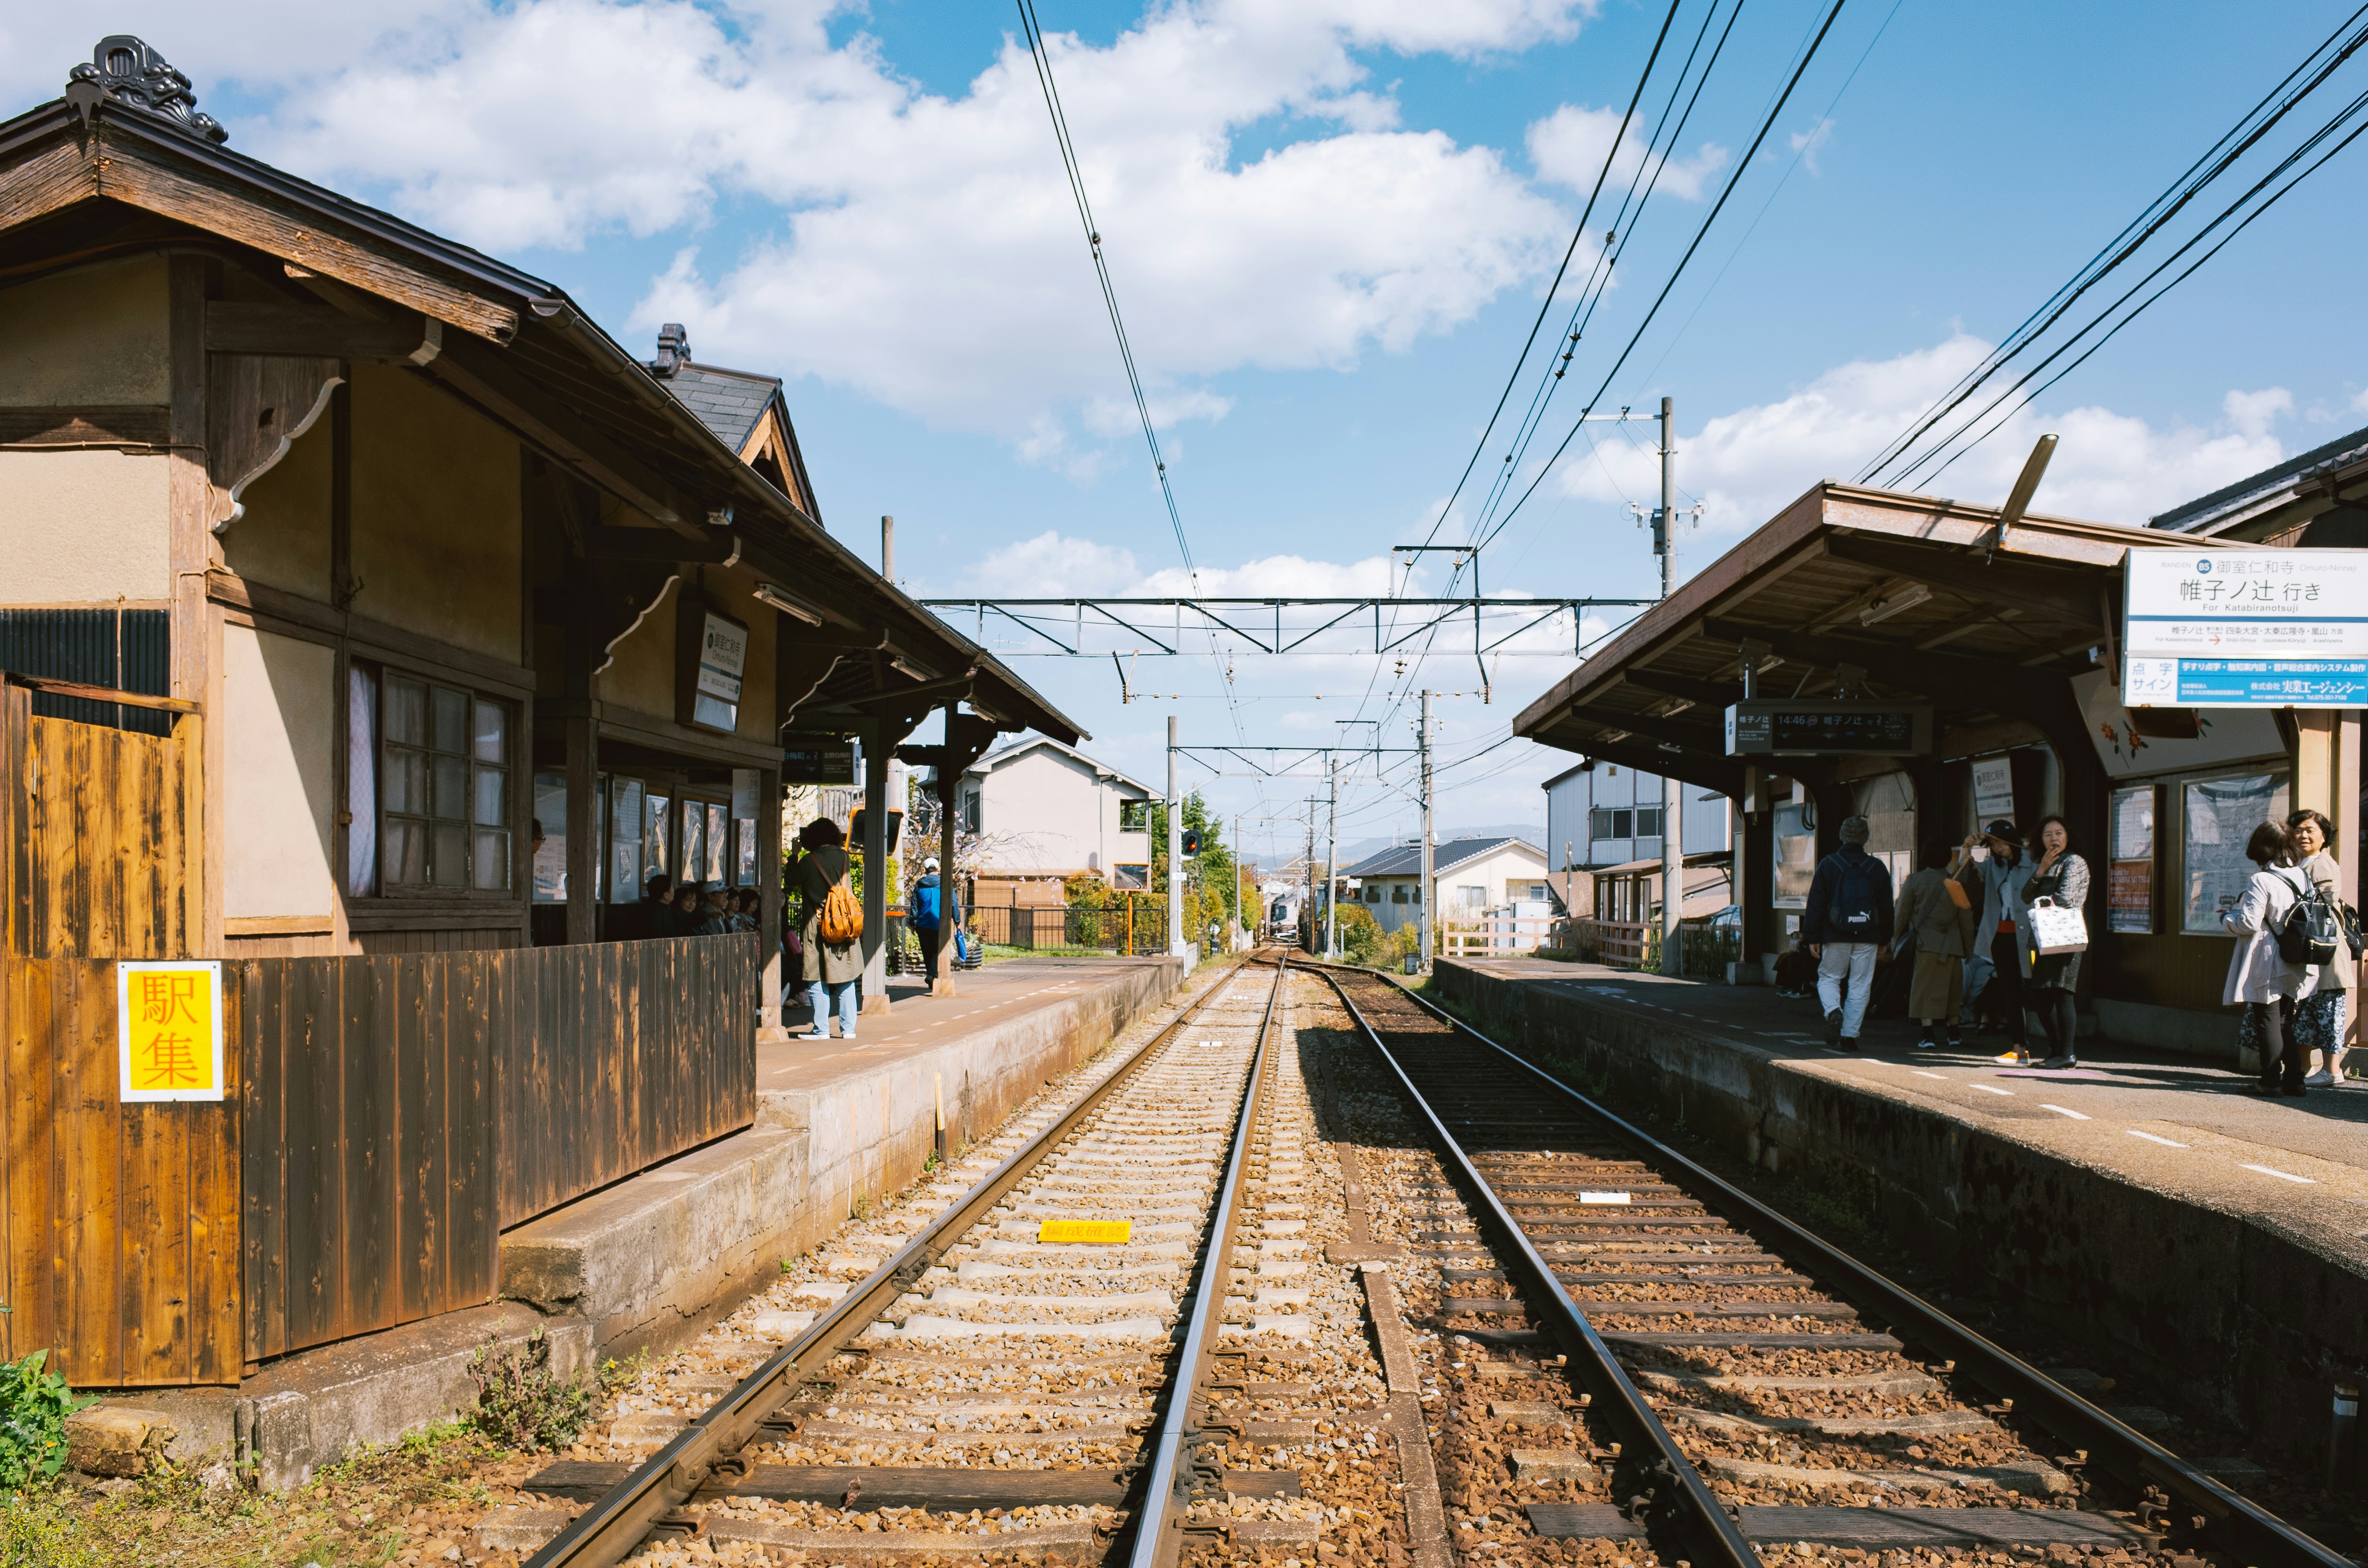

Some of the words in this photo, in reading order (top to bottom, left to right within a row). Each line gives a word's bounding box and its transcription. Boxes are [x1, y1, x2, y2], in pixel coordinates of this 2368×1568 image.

[2198, 563, 2210, 571] B5
[2216, 560, 2294, 575] 御室仁和寺
[2300, 563, 2357, 573] Omuro-Ninnaji
[2180, 579, 2274, 601] 帷子ノ辻
[2283, 583, 2320, 601] 行き
[2225, 603, 2298, 613] Katabiranotsuji
[2171, 626, 2203, 635] 帷子ノ辻
[2133, 678, 2171, 690] サイン
[2251, 682, 2281, 690] 株式会社
[2282, 680, 2365, 693] 実業エージェンシー
[1778, 715, 1805, 724] 14:46
[1044, 1225, 1126, 1237] 編成確認
